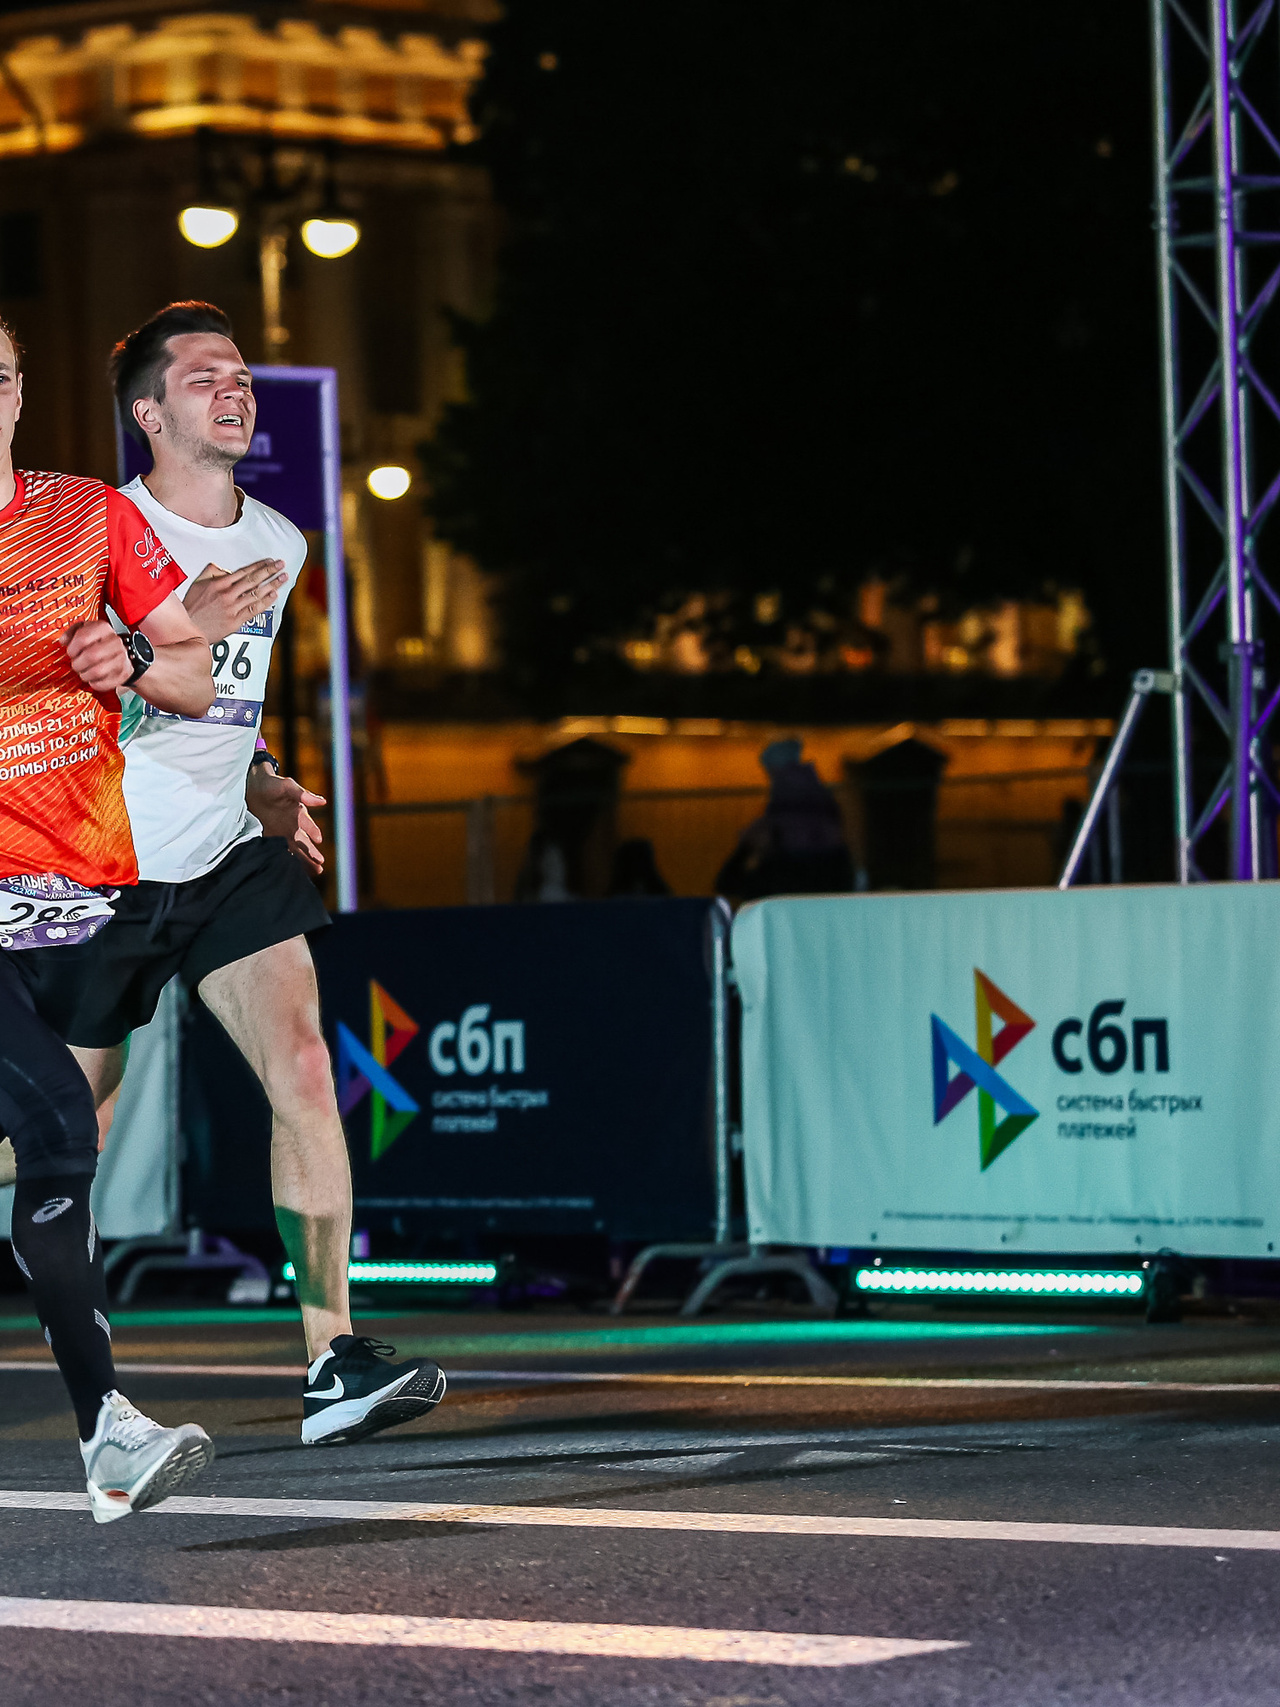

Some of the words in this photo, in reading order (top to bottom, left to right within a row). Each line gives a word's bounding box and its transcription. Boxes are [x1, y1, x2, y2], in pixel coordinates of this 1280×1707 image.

[25, 577, 59, 592] 42.2
[62, 574, 85, 588] КМ
[64, 595, 85, 608] КМ
[246, 613, 266, 628] ОЧИ
[212, 640, 252, 680] 96
[216, 683, 236, 695] НИС
[46, 714, 77, 732] 21.1
[48, 733, 79, 750] 10.0
[81, 726, 98, 744] КМ
[50, 752, 79, 770] 03.0
[80, 744, 99, 763] КМ
[428, 1003, 525, 1077] сбп
[1051, 998, 1170, 1076] сбп
[1056, 1095, 1124, 1112] система
[1128, 1088, 1203, 1117] быстрых
[1057, 1117, 1137, 1140] платежей
